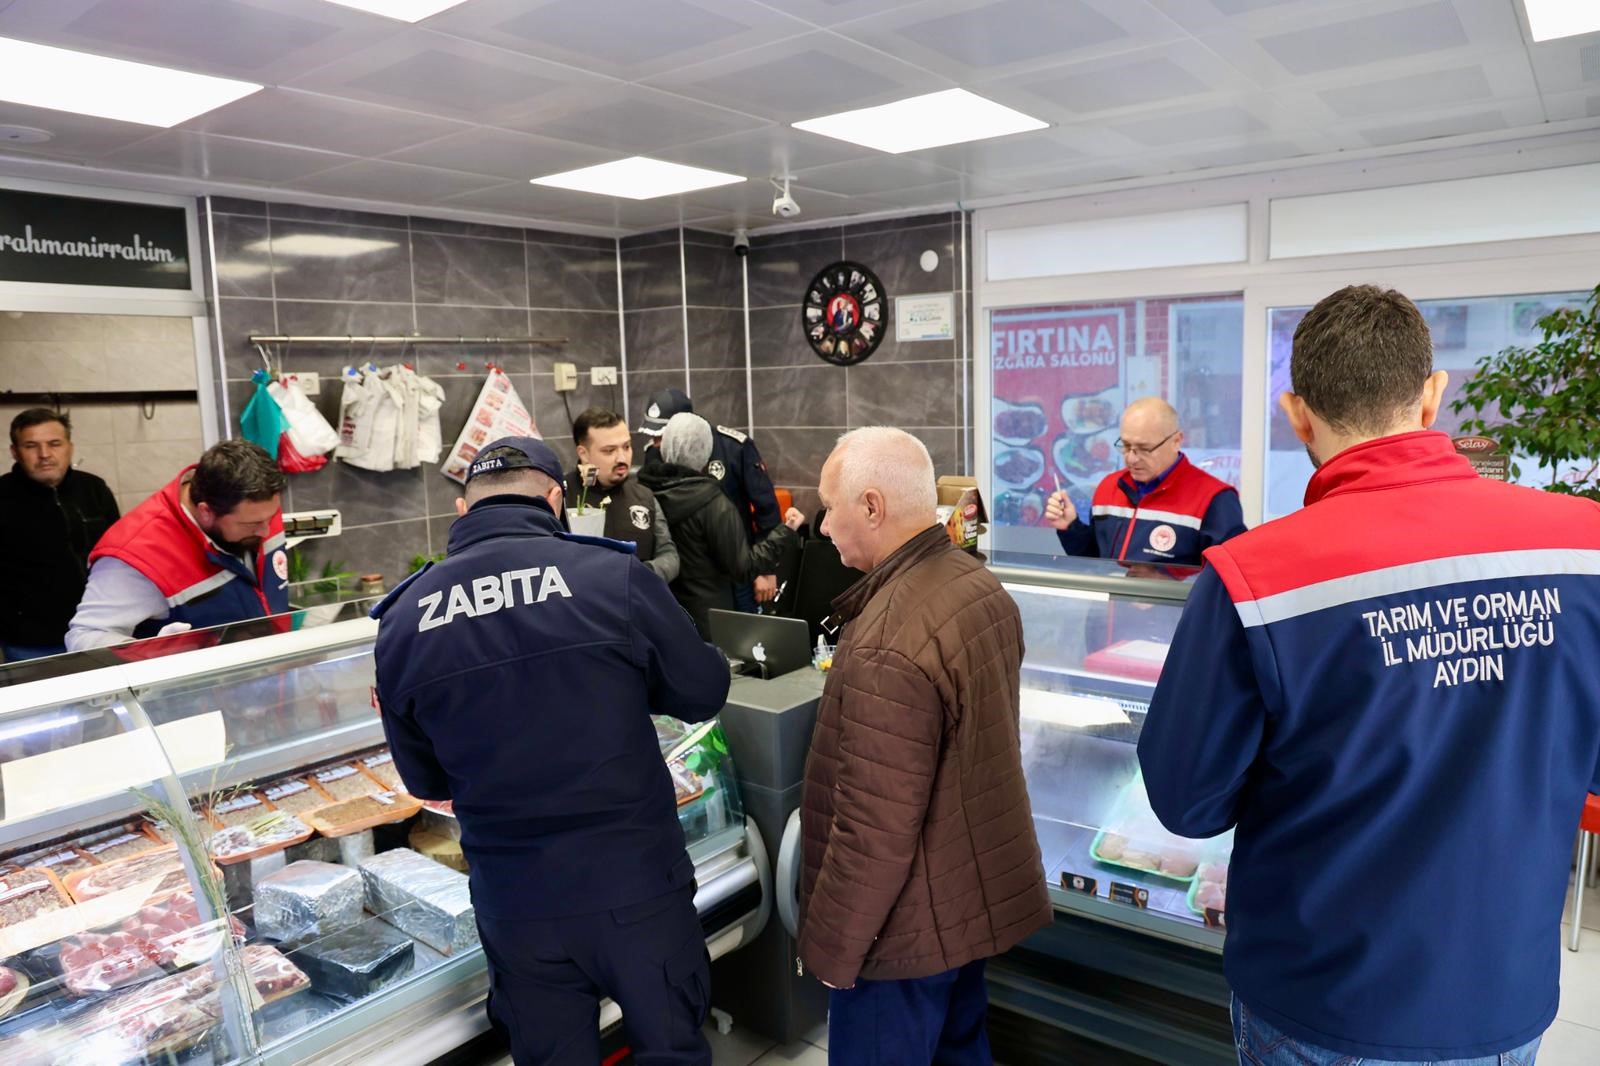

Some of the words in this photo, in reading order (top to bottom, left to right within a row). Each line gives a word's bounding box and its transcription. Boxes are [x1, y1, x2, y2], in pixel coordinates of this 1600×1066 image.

[992, 324, 1114, 357] FIRTINA
[992, 354, 1045, 370] ZGARA
[1050, 351, 1116, 368] SALONU
[472, 459, 502, 473] ZABITA
[418, 565, 572, 632] ZABITA
[1362, 602, 1433, 637] TARIM
[1436, 597, 1467, 625] VE
[1472, 588, 1561, 620] ORMAN
[1406, 614, 1554, 662] MÜDÜRLÜĞÜ
[1433, 654, 1504, 688] AYDIN
